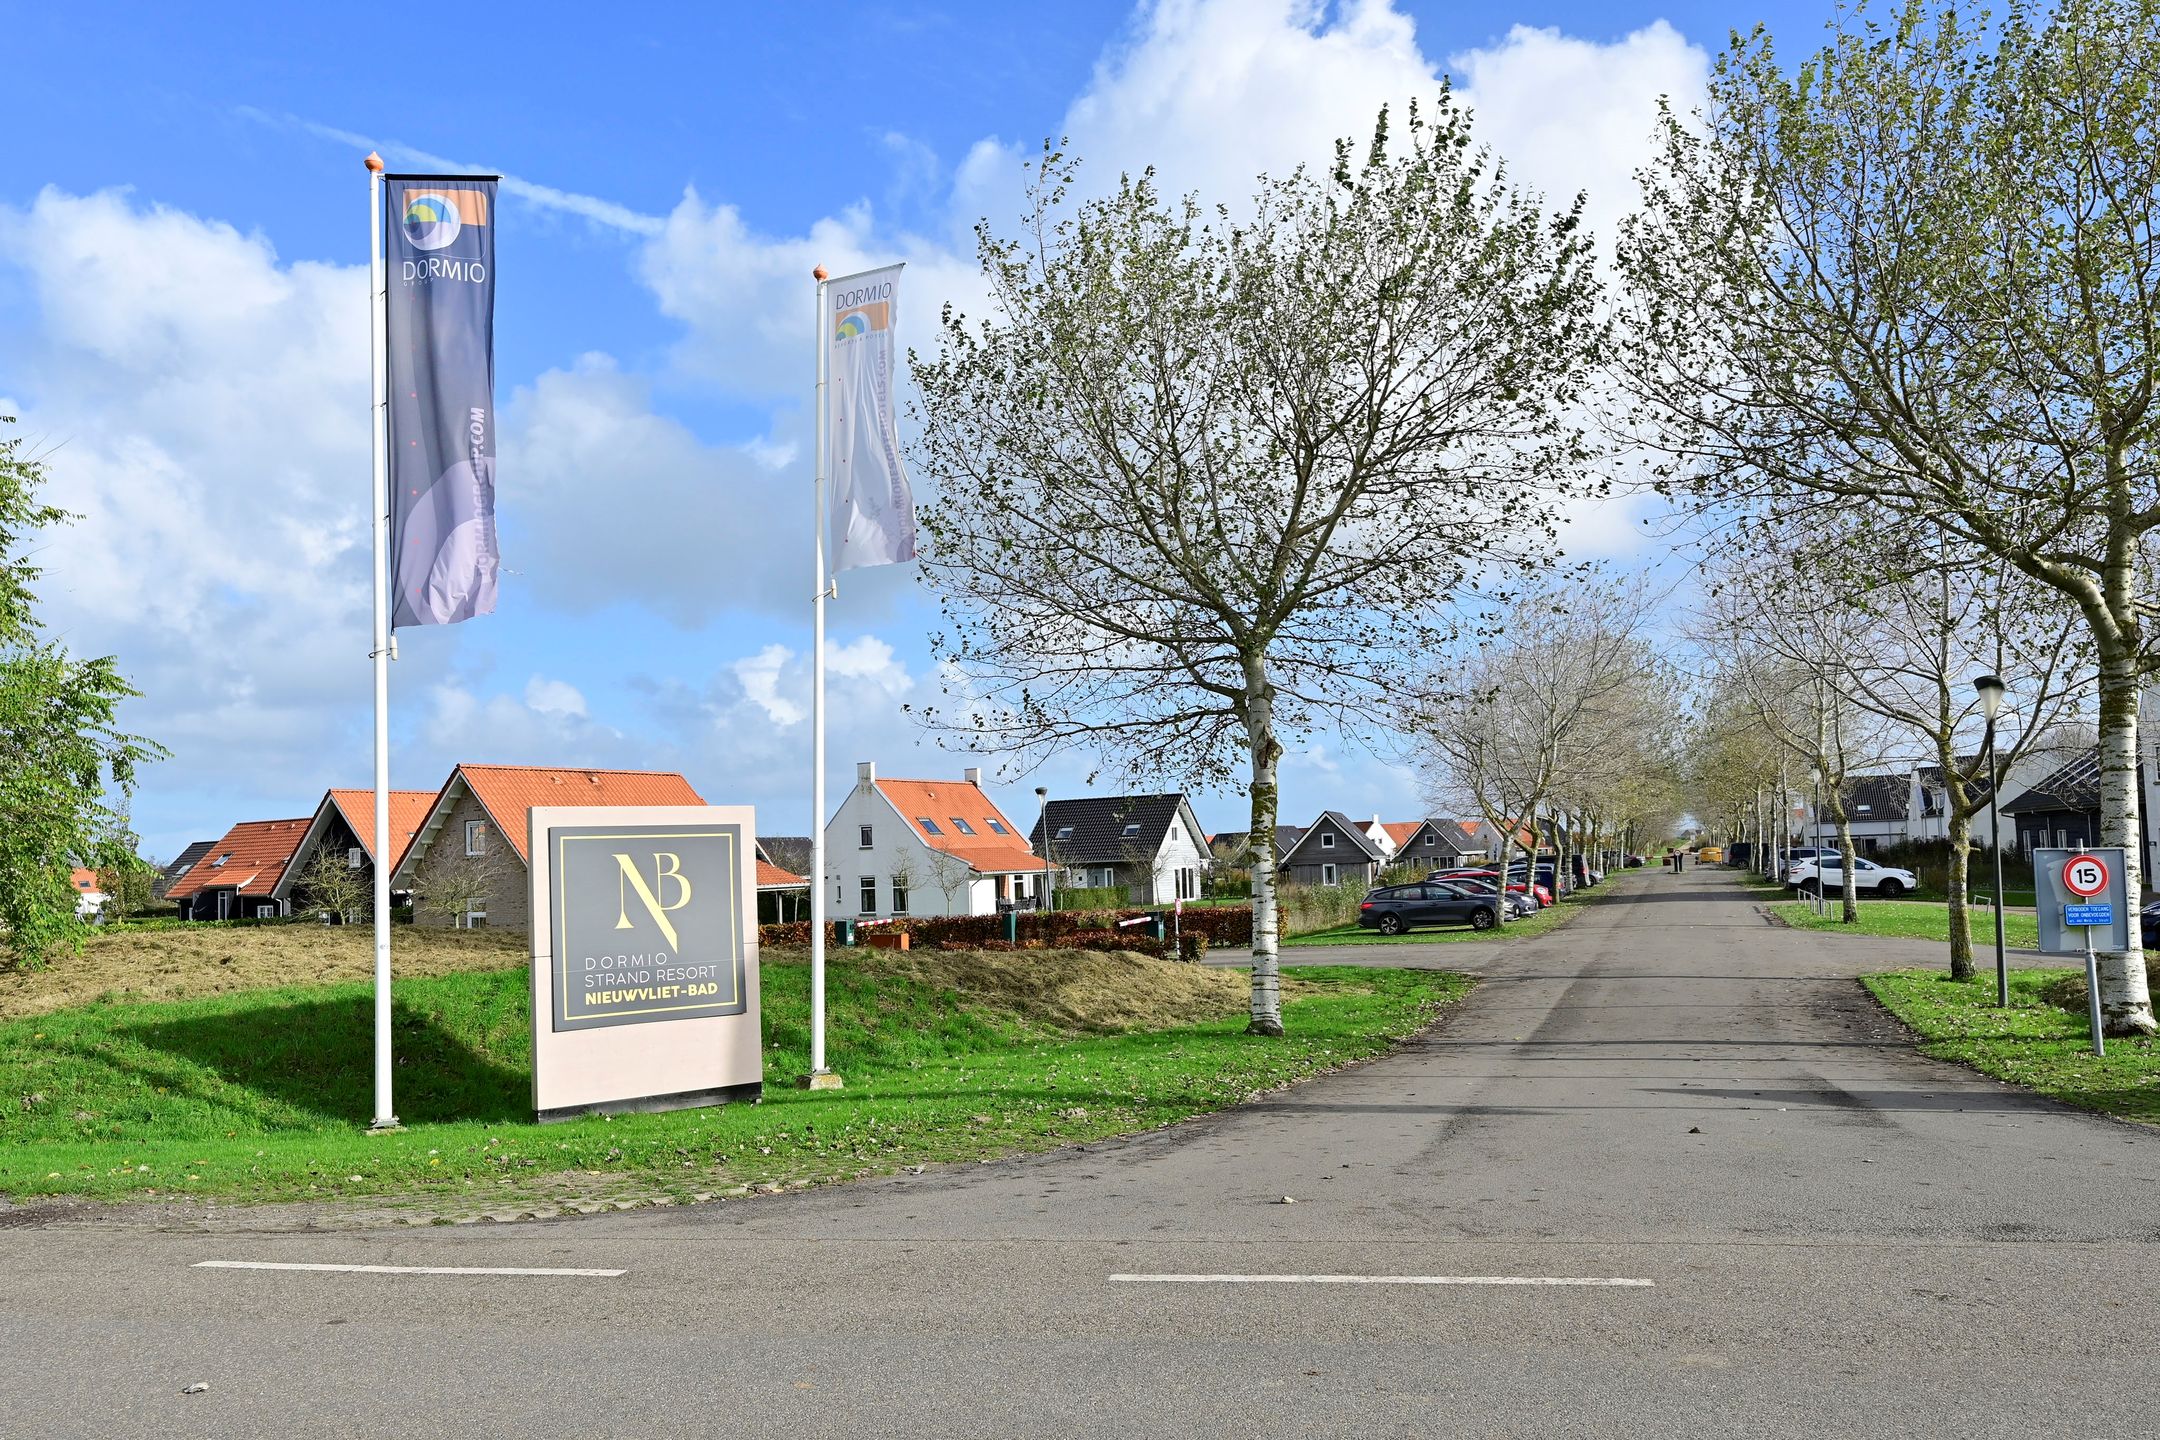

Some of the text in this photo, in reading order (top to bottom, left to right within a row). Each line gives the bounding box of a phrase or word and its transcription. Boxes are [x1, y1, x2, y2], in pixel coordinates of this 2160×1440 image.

[403, 257, 486, 283] DORMIO
[835, 282, 892, 310] DORMIO
[2076, 868, 2097, 884] 15
[585, 952, 667, 970] DORMIO
[584, 965, 718, 988] STRAND RESORT
[585, 982, 719, 1005] NIEUWVLIET-BAD
